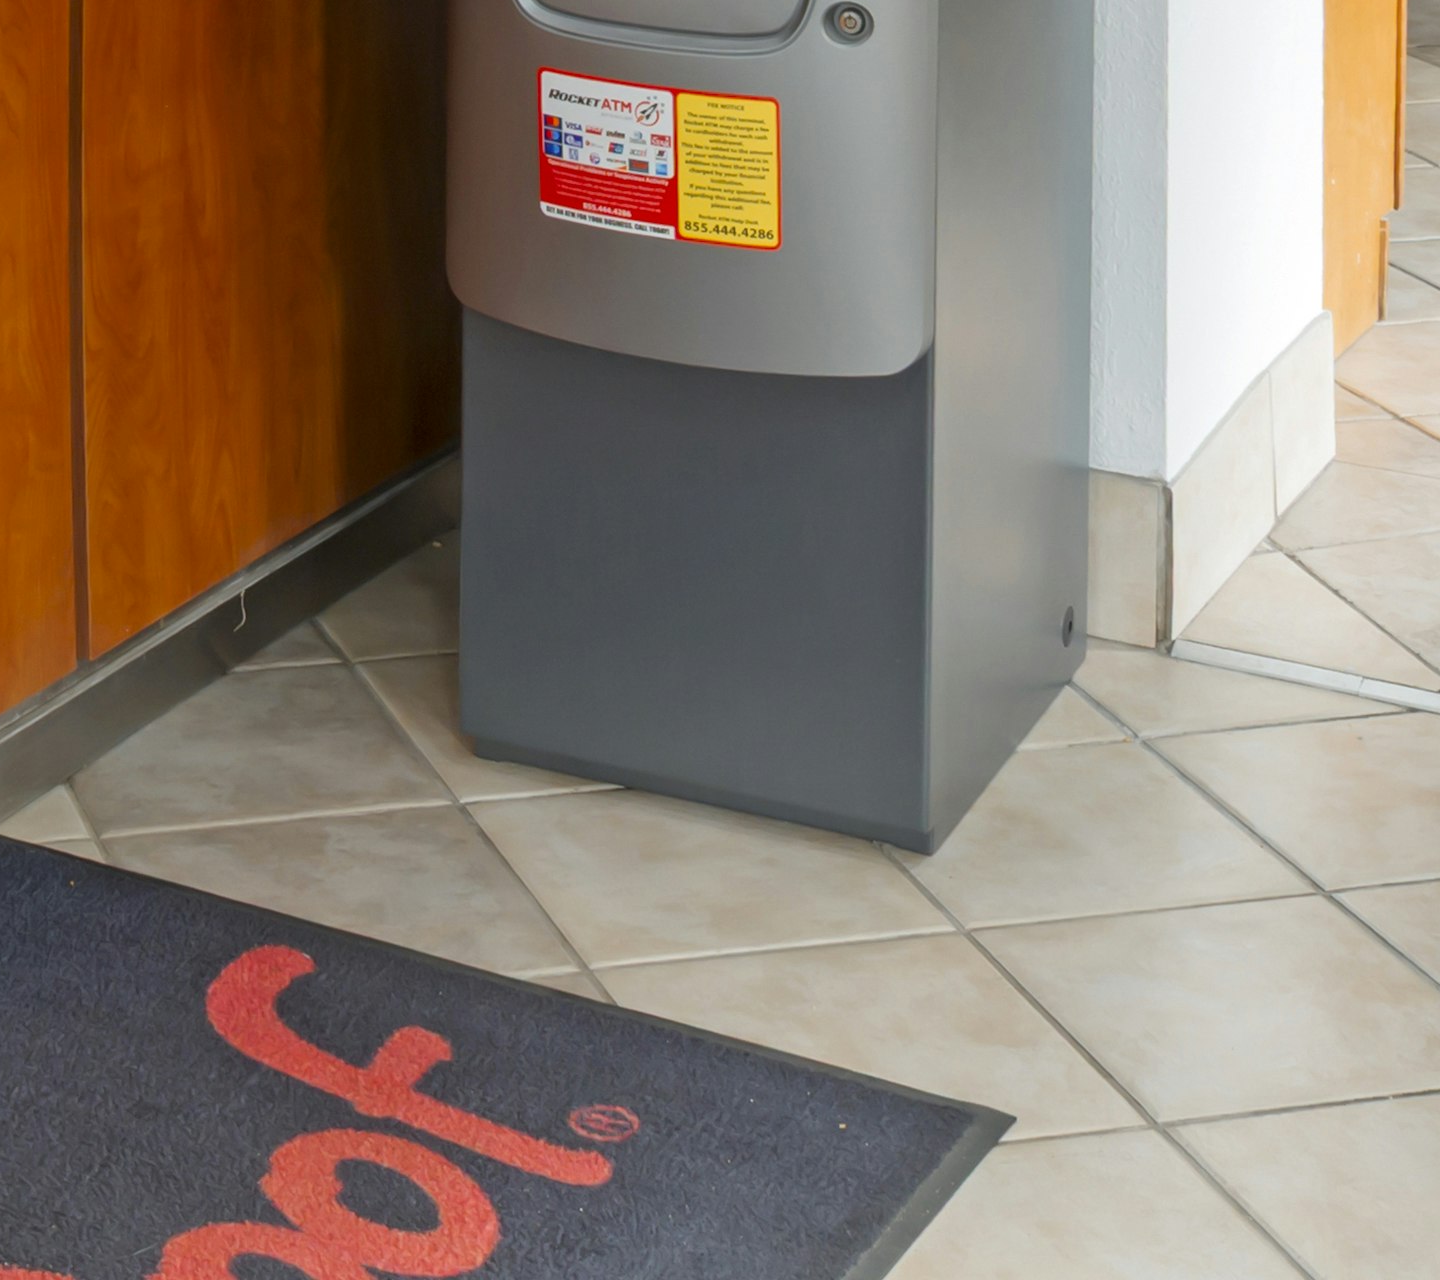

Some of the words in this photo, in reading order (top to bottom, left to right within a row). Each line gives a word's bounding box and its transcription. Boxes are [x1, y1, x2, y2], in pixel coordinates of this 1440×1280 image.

[601, 98, 632, 113] ATM
[565, 121, 582, 131] VISA
[684, 221, 774, 240] 855.444.4286
